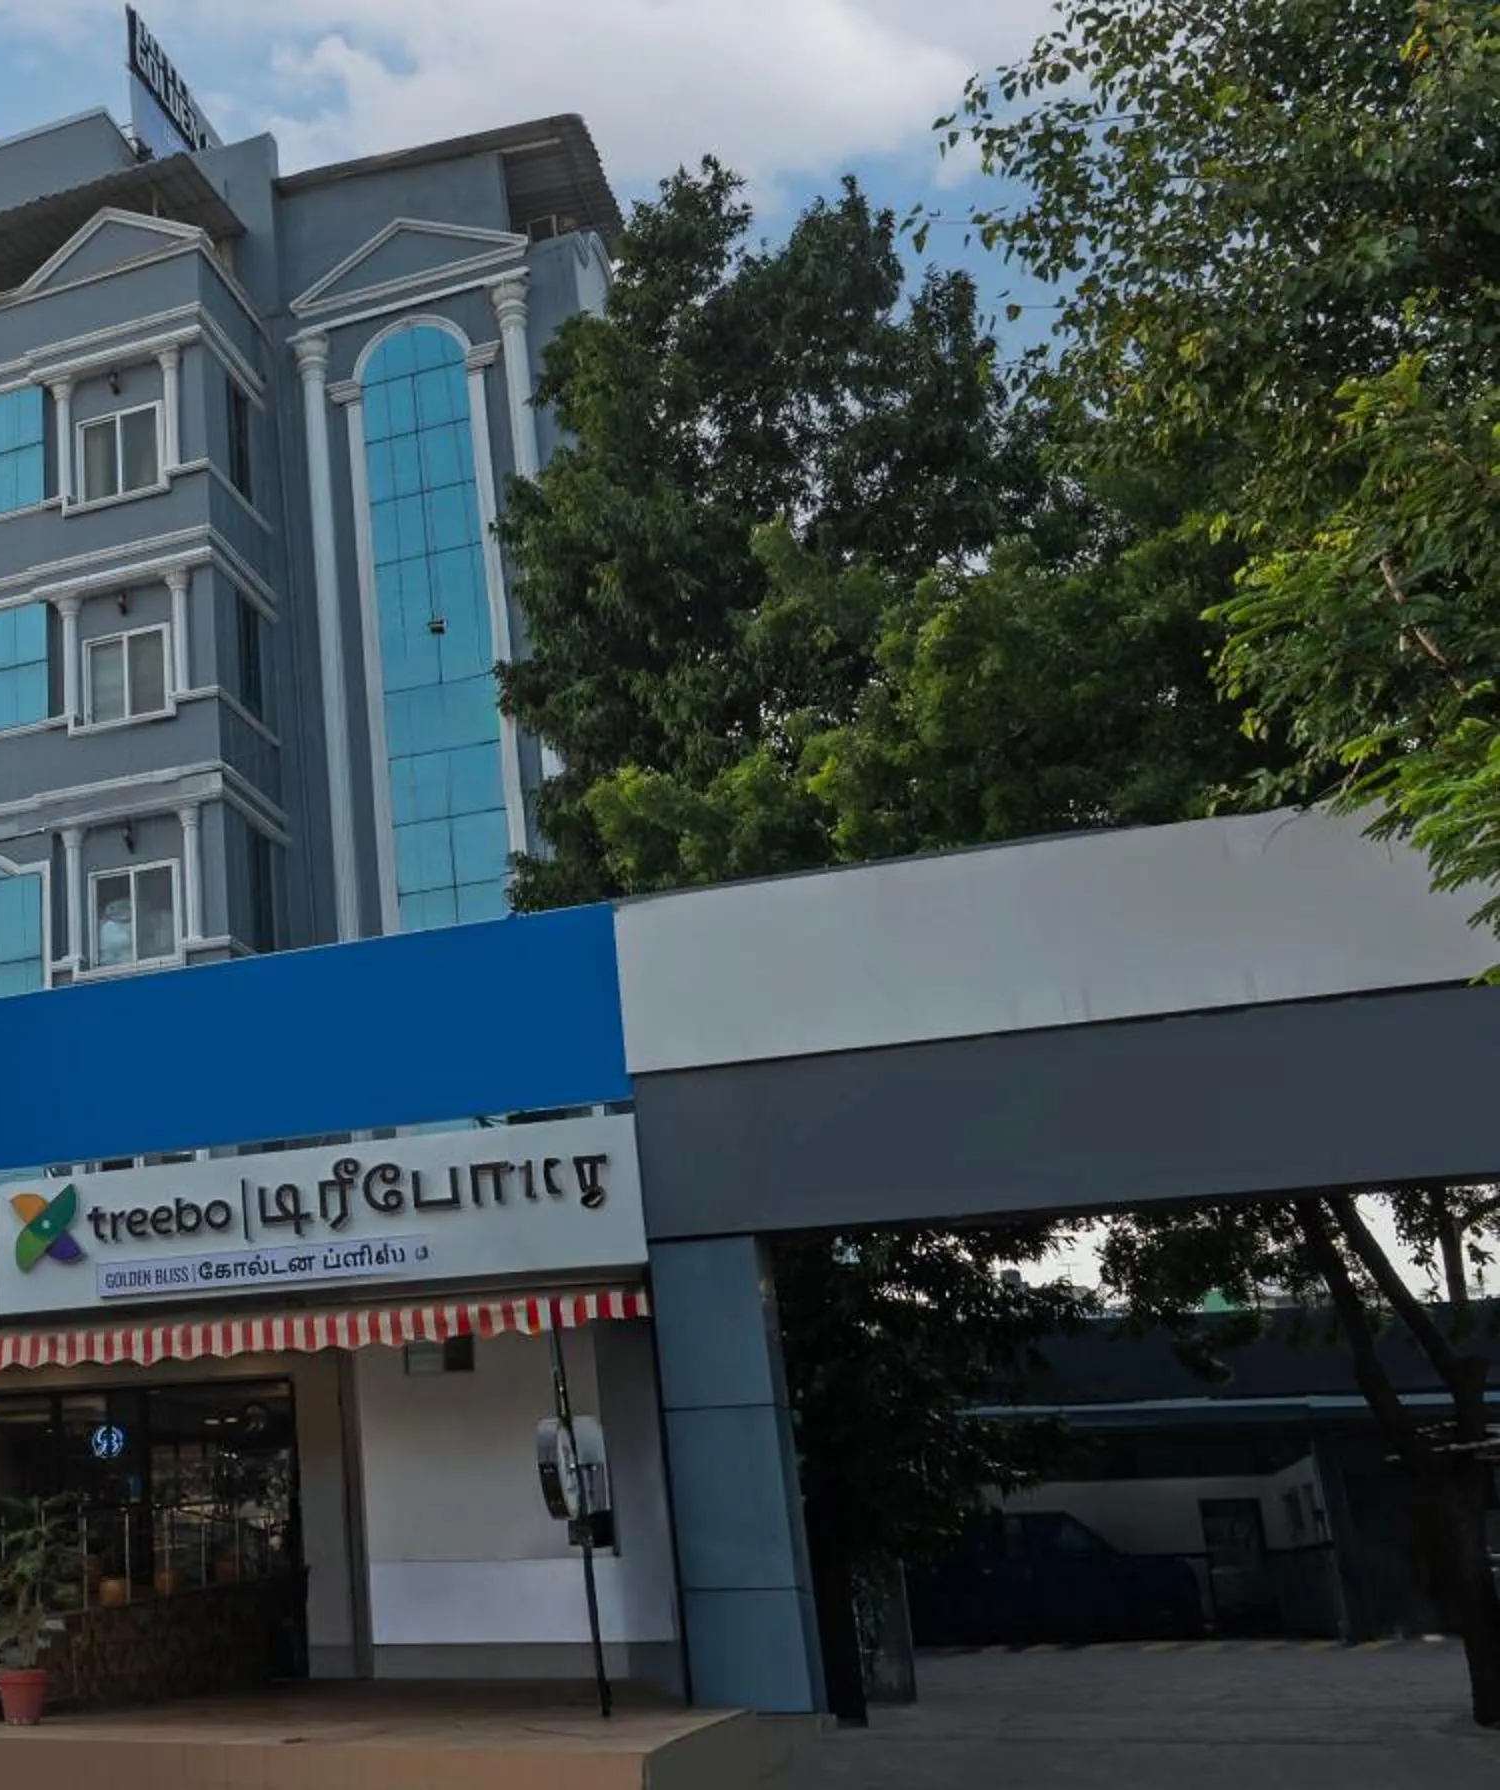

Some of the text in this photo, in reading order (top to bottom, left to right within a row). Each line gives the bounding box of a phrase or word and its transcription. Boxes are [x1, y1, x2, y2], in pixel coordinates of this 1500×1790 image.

[87, 1197, 232, 1242] treebo
[105, 1263, 189, 1289] GOLDEN BLISS
